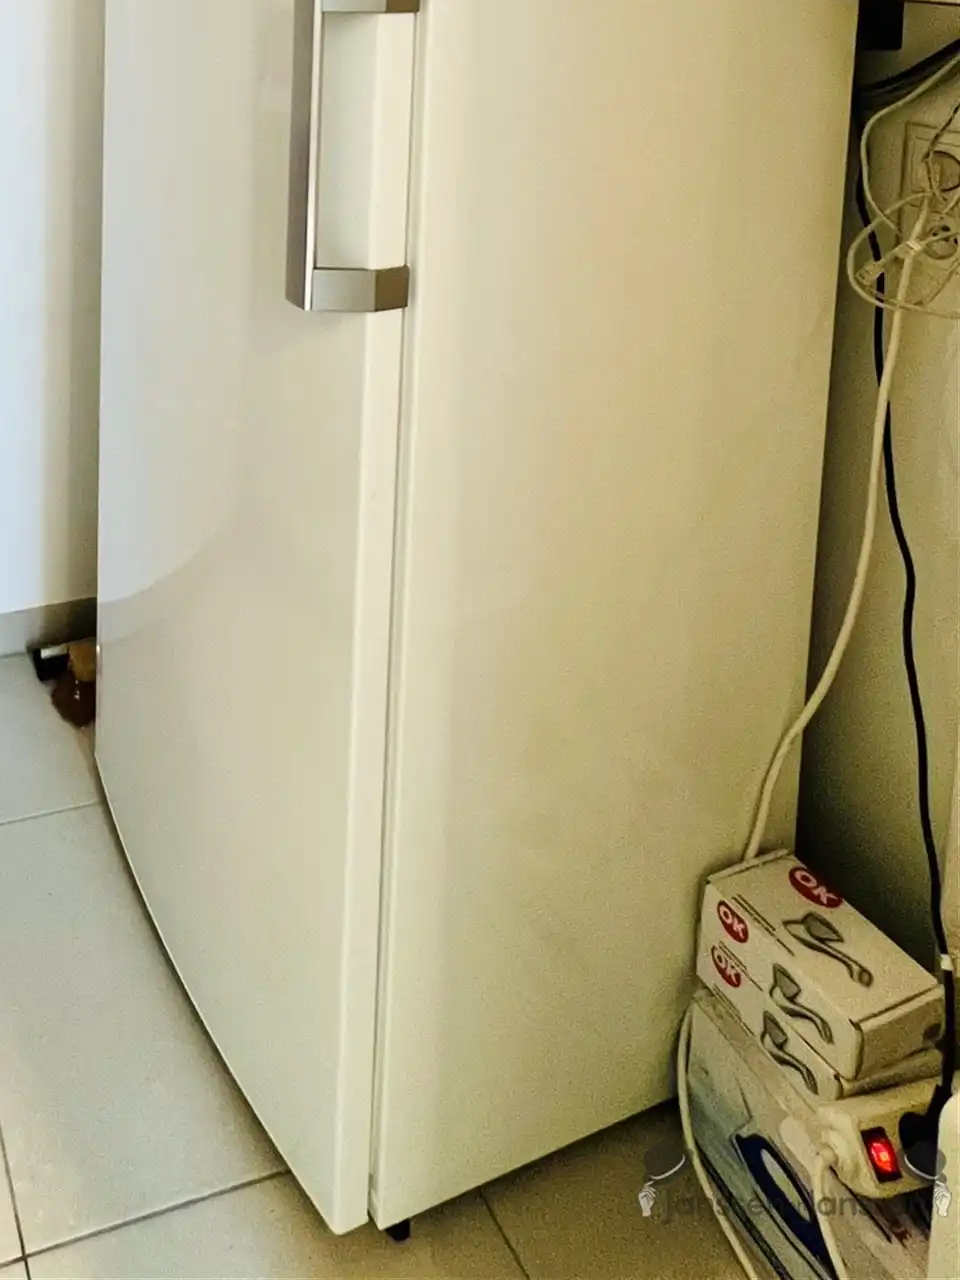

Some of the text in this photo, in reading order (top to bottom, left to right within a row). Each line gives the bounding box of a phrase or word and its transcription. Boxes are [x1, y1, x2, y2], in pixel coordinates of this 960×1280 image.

[793, 869, 840, 905] OK
[719, 905, 746, 940] OK
[715, 953, 739, 980] OK
